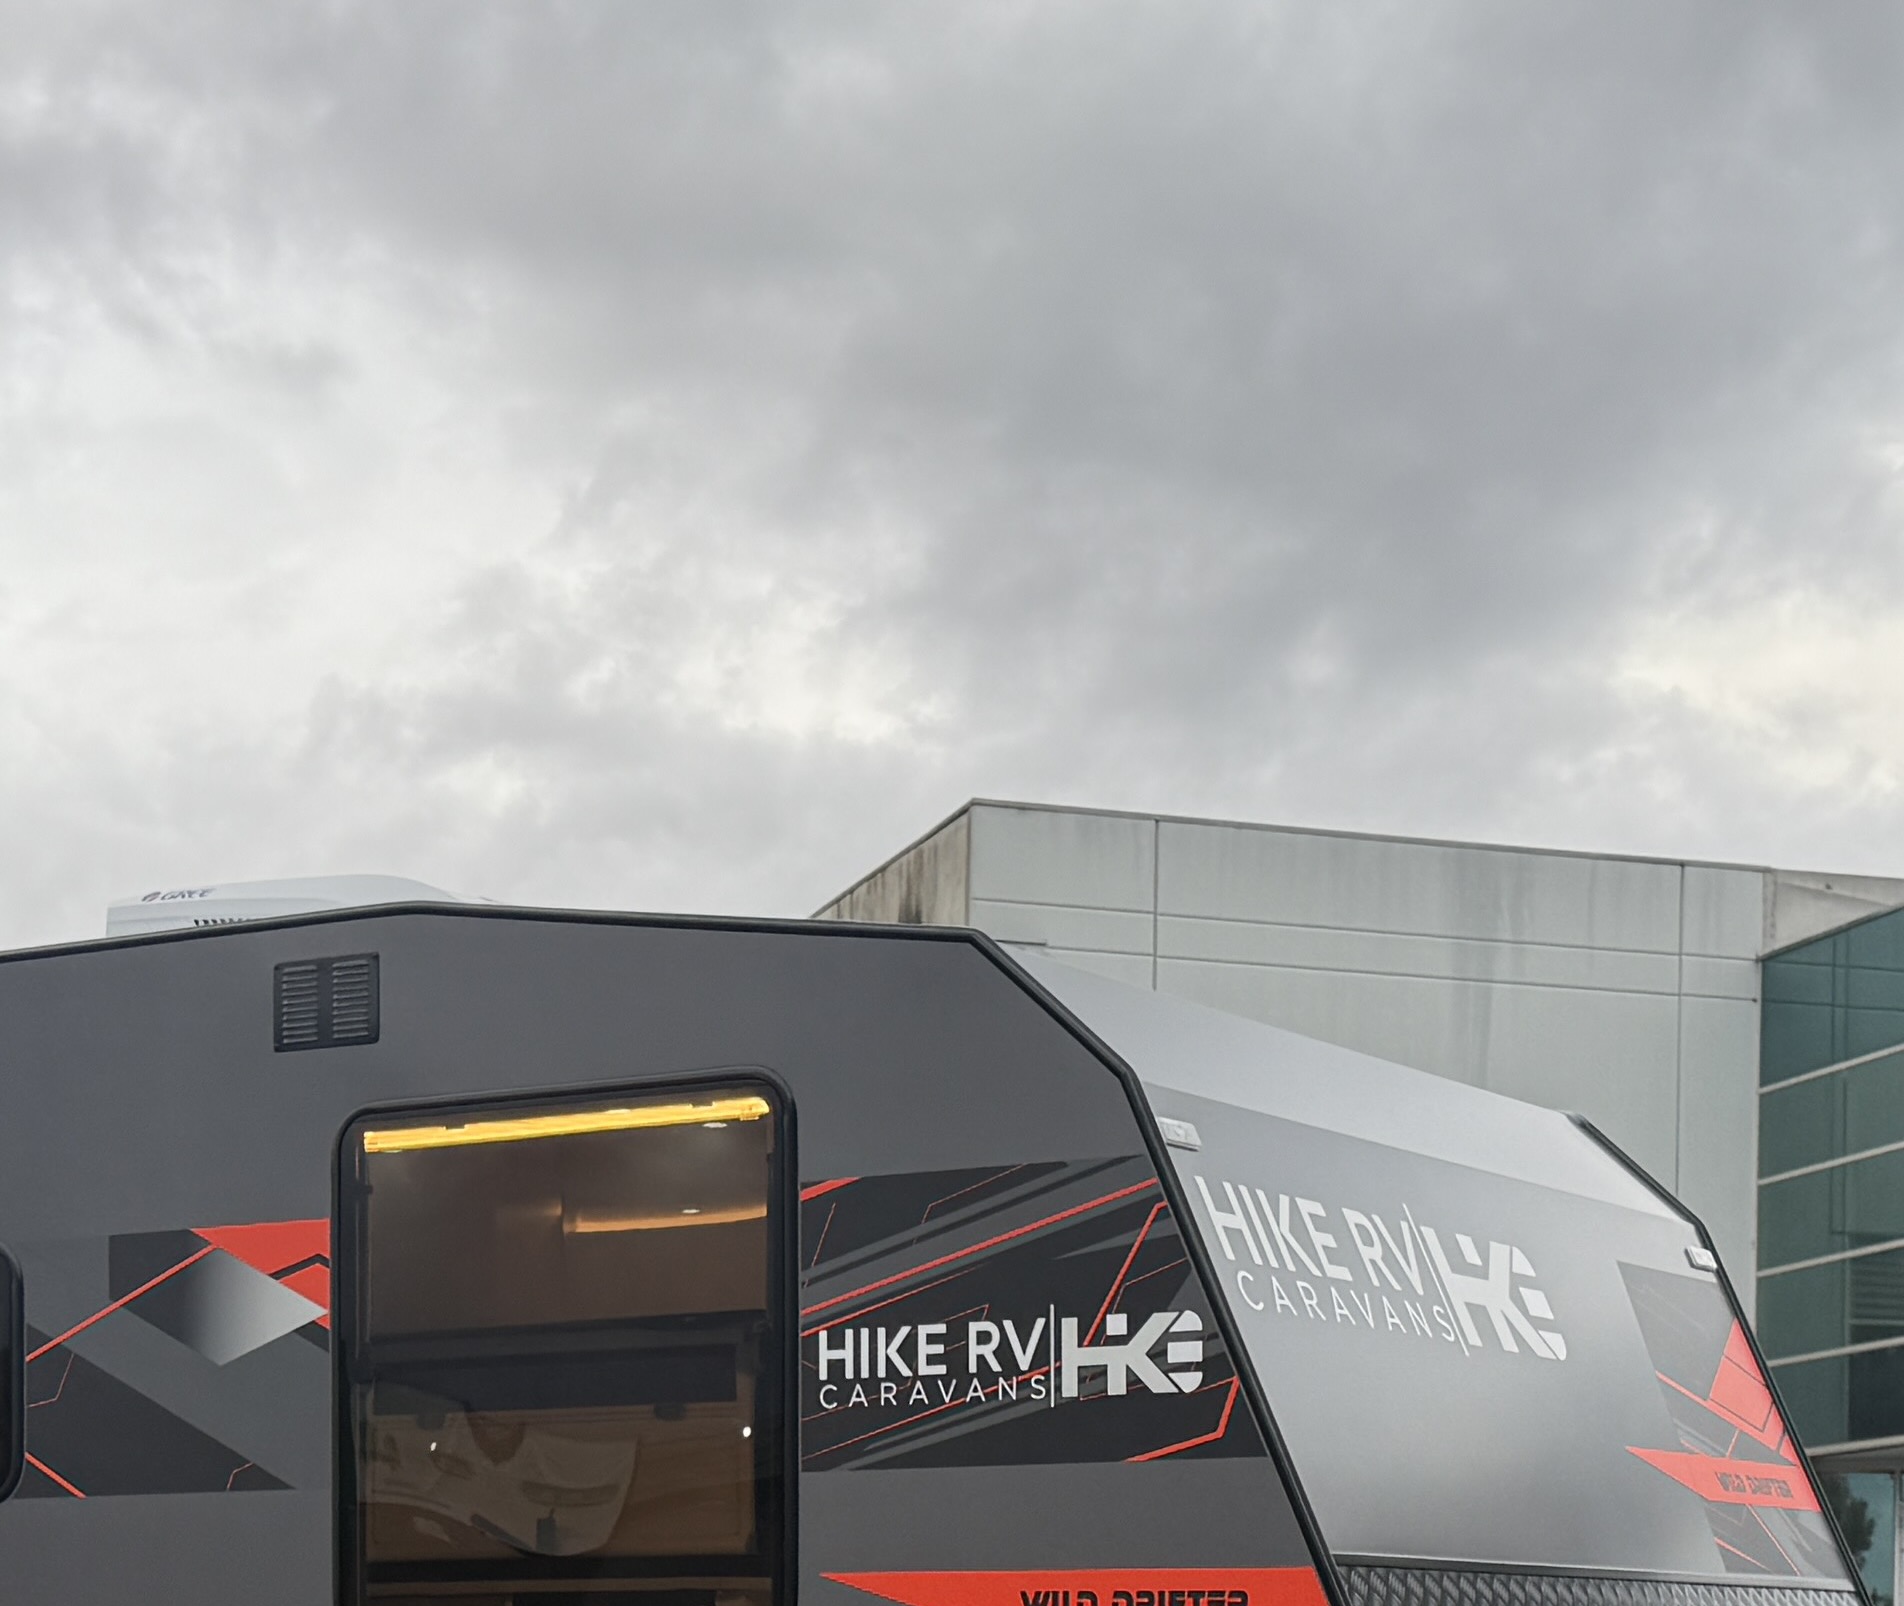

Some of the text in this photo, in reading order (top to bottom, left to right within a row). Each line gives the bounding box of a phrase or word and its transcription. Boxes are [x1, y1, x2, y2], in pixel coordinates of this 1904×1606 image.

[1195, 1175, 1353, 1282] HIKE
[1341, 1206, 1424, 1296] RV
[1236, 1269, 1456, 1343] CARAVANS
[819, 1323, 947, 1381] HIKE
[969, 1316, 1046, 1374] RV
[819, 1374, 1046, 1409] CARAVANS
